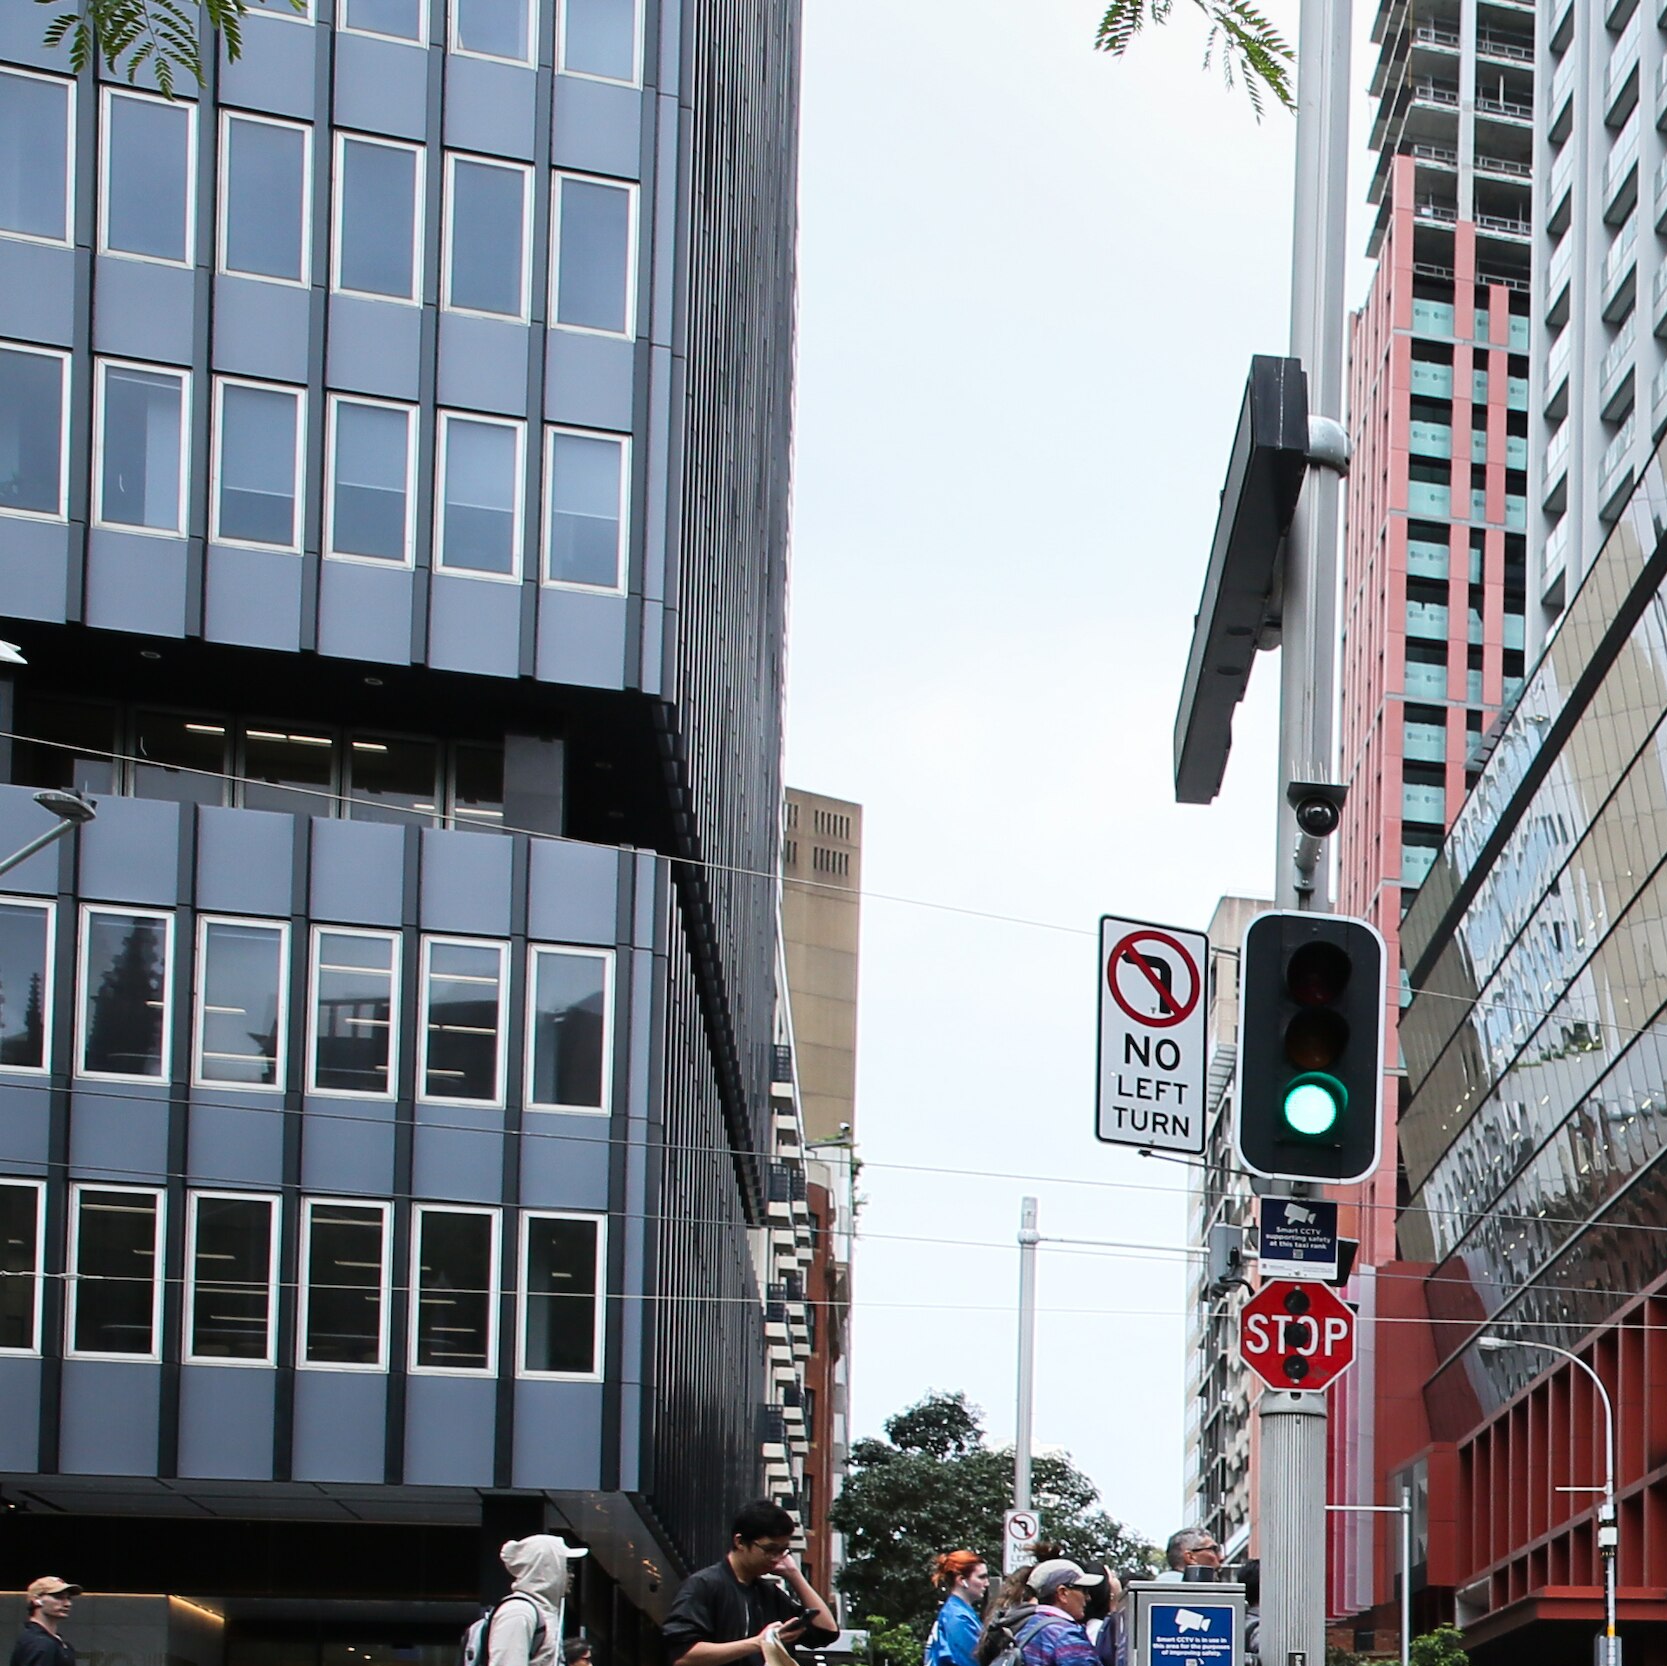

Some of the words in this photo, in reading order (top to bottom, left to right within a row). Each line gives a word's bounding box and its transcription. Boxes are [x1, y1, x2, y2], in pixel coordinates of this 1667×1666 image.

[1125, 1032, 1181, 1071] NO
[1118, 1074, 1188, 1105] LEFT
[1112, 1106, 1189, 1137] TURN
[1265, 1234, 1307, 1243] supporting
[1308, 1236, 1331, 1244] safety
[1276, 1226, 1298, 1234] Smart
[1245, 1313, 1348, 1356] STOP
